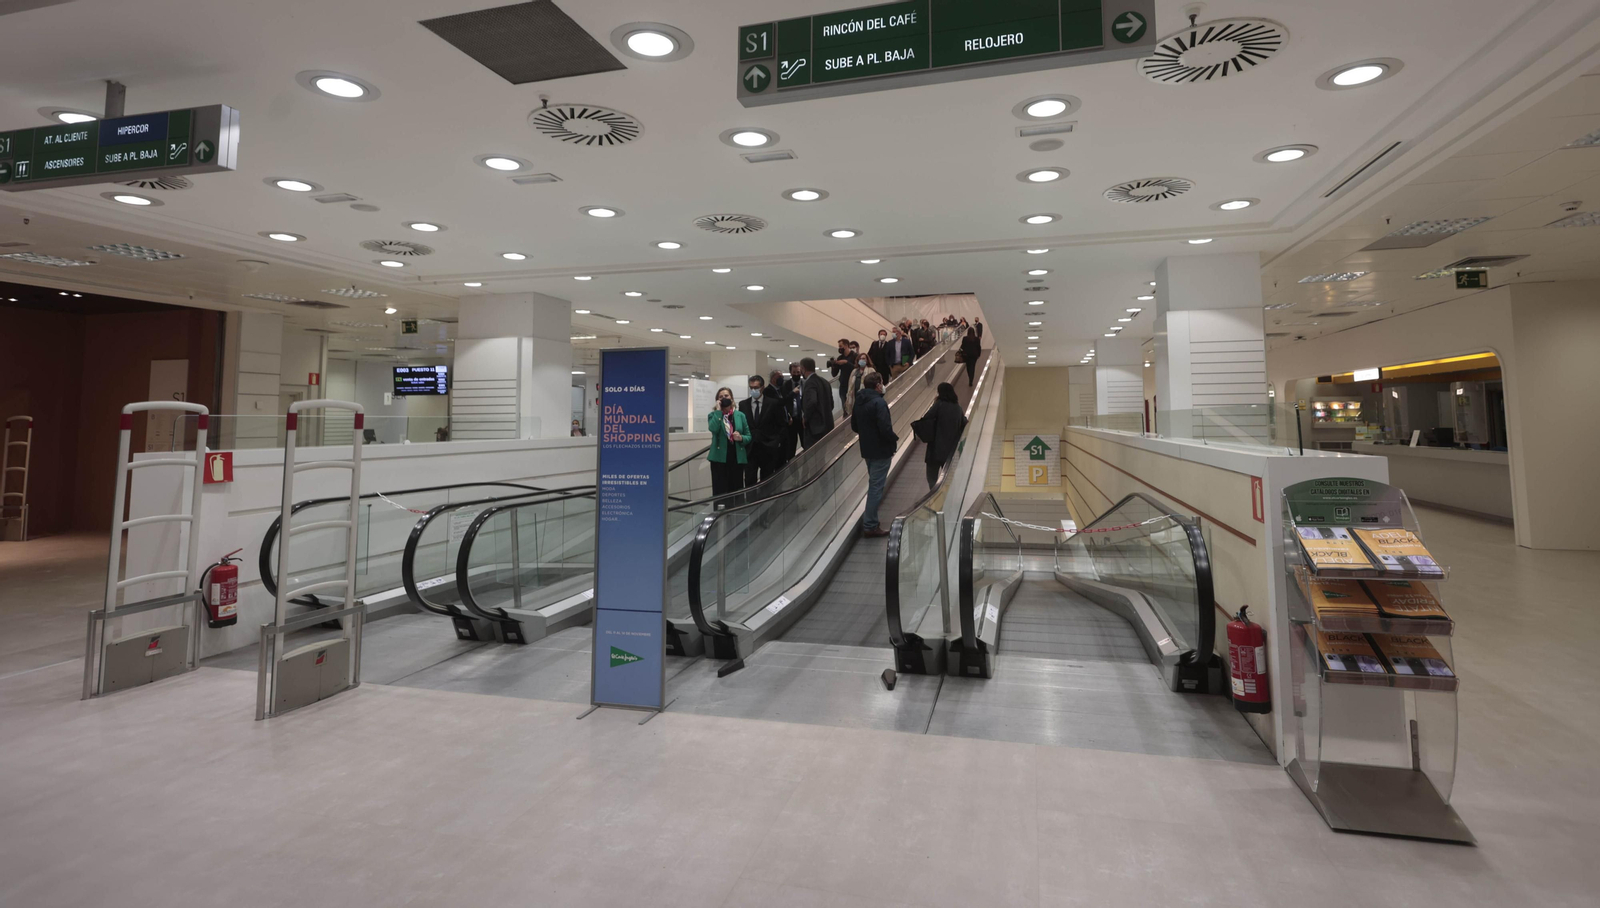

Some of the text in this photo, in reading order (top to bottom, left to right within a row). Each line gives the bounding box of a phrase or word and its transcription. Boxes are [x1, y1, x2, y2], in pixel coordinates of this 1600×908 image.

[823, 10, 917, 37] RINCÓN DEL CAFÉ
[746, 31, 767, 53] S1
[964, 32, 1024, 51] RELOJERO
[825, 48, 915, 70] SUBE A PL. BAJA
[117, 123, 149, 135] HIPERCOR
[44, 130, 88, 144] AT. AL CLIENTE
[44, 157, 84, 169] ASCENSORES
[105, 153, 121, 164] SUBE
[123, 152, 128, 161] A
[140, 149, 158, 160] BAJA
[604, 404, 624, 414] DÍA
[604, 415, 655, 424] MUNDIAL
[604, 424, 625, 433] DEL
[603, 434, 661, 442] SHOPPING
[1031, 445, 1042, 455] S1
[1032, 468, 1043, 482] P
